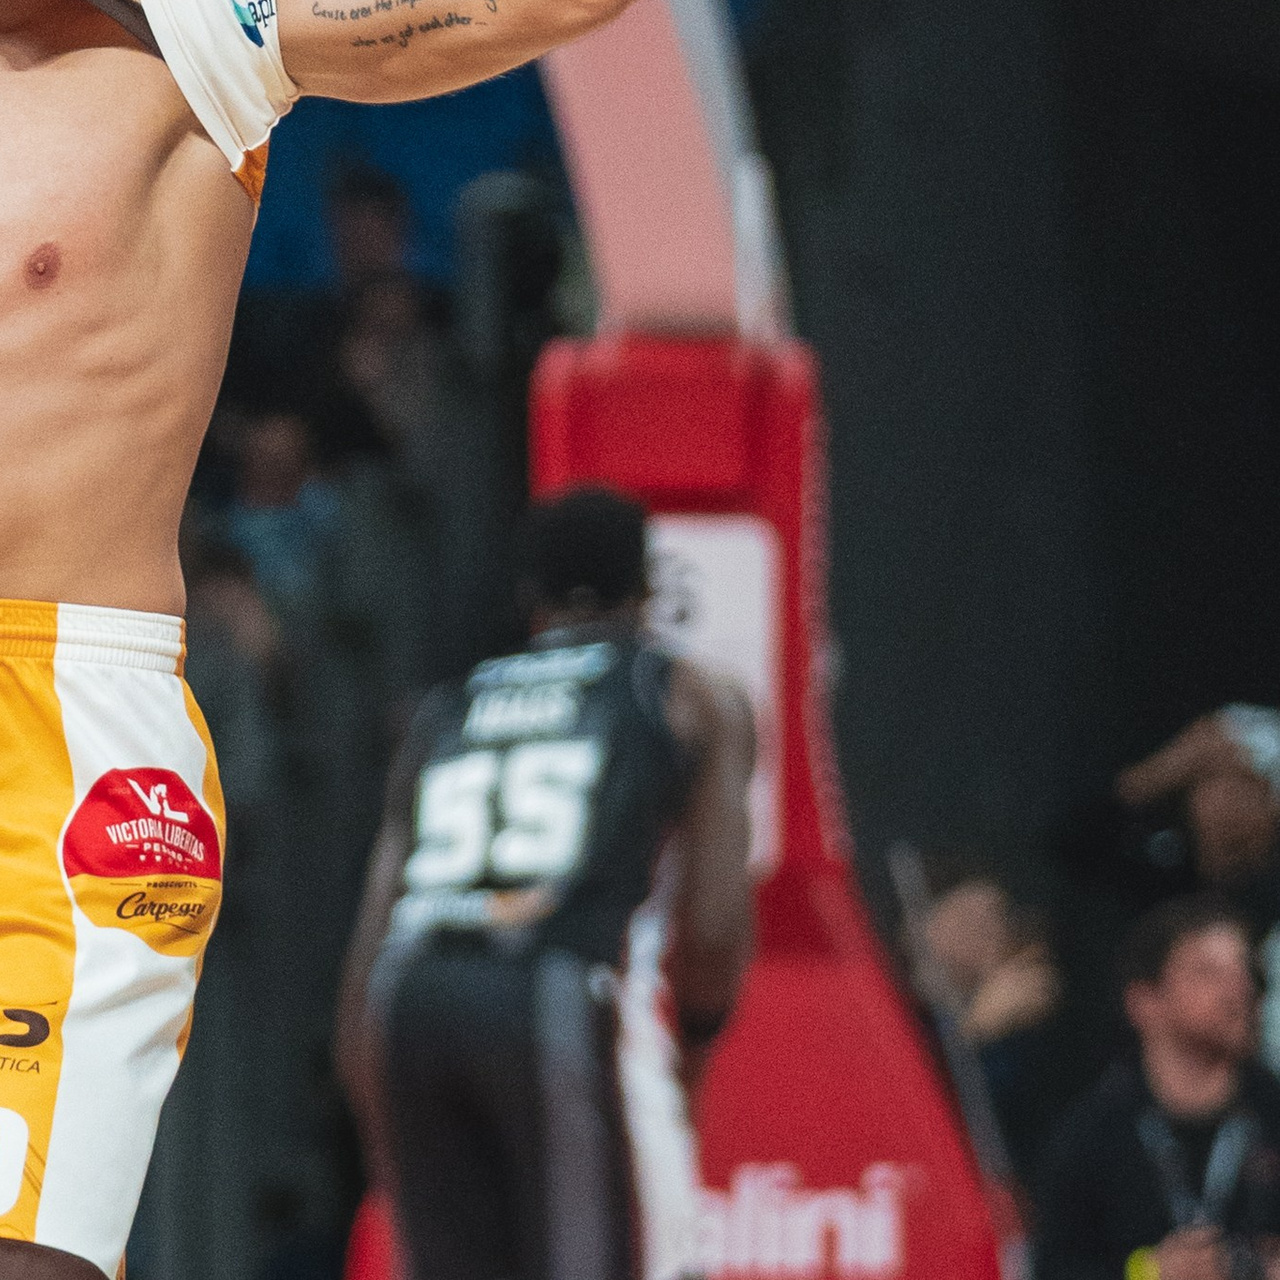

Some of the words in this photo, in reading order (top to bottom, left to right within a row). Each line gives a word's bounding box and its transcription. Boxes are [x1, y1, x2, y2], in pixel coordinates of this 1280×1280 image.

[105, 818, 164, 845] VICTORIA
[164, 823, 205, 862] LIBERTAS
[405, 739, 602, 887] 55
